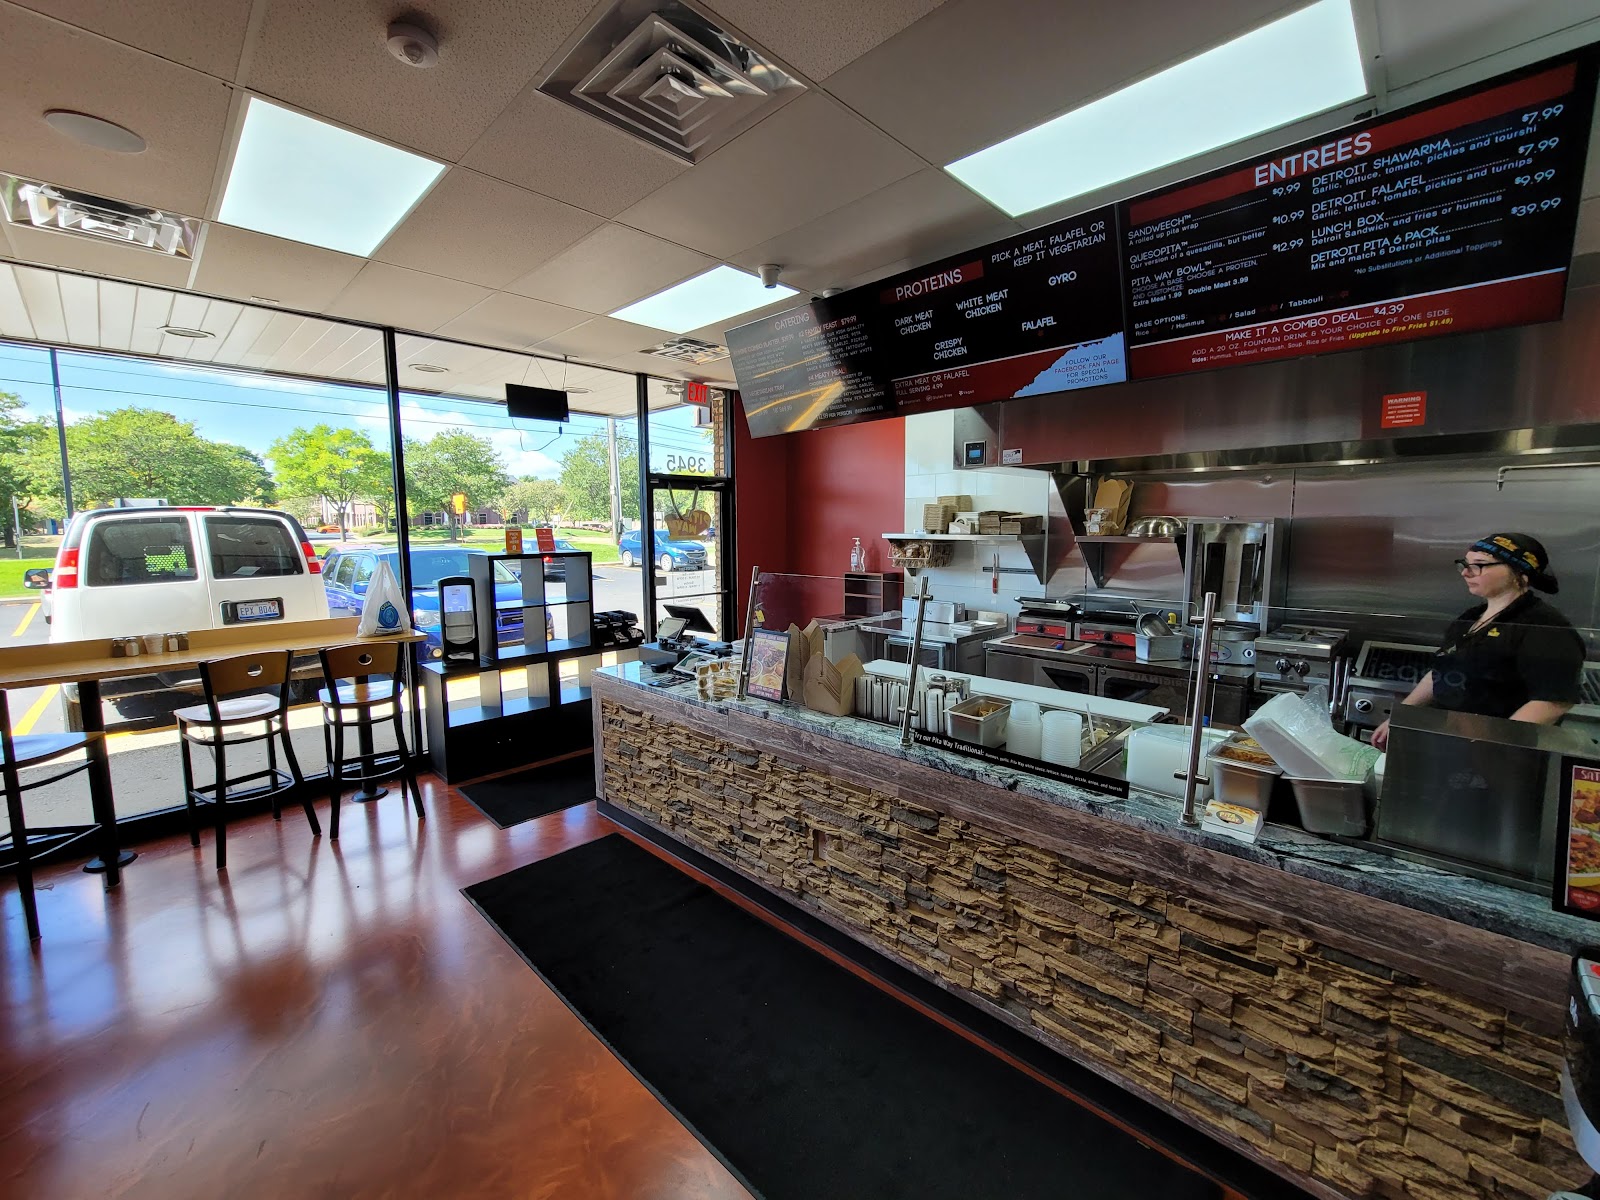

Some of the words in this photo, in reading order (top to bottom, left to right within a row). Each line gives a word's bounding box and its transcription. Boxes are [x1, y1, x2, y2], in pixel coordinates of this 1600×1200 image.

[1522, 104, 1563, 125] $7.99
[1427, 147, 1465, 164] pickles
[1470, 138, 1490, 150] and
[1495, 125, 1537, 142] tourshi
[1518, 137, 1559, 156] $7.99
[1255, 133, 1372, 186] ENTREES
[1313, 163, 1368, 187] DETROIT
[1373, 139, 1451, 169] SHAWARMA
[1425, 175, 1462, 192] pickles
[1467, 168, 1488, 180] and
[1492, 157, 1532, 174] turnips
[1515, 169, 1555, 187] $9.99
[1272, 182, 1300, 196] $9.99
[1312, 190, 1366, 213] DETROIT
[1372, 175, 1426, 197] FALAFEL
[1511, 197, 1561, 217] $39.99
[1272, 210, 1304, 225] $10.99
[1312, 234, 1341, 246] Detroit
[1345, 221, 1389, 238] Sandwich
[1393, 217, 1411, 226] and
[1415, 210, 1437, 221] fries
[1442, 205, 1452, 215] or
[1456, 195, 1502, 211] hummus
[1312, 221, 1351, 239] LUNCH
[1358, 212, 1385, 227] BOX
[992, 252, 1010, 263] PICK
[1014, 247, 1020, 256] A
[1049, 227, 1086, 245] FALAFEL
[1090, 221, 1105, 233] OR
[1135, 234, 1154, 244] rolled
[1156, 232, 1164, 240] up
[1167, 228, 1179, 237] pita
[1182, 222, 1199, 232] wrap
[1013, 254, 1033, 267] KEEP
[1036, 250, 1046, 261] IT
[1049, 233, 1106, 257] VEGETARIAN
[1131, 260, 1142, 270] Our
[1144, 256, 1168, 266] version
[1171, 252, 1177, 260] of
[1242, 230, 1265, 241] better
[1272, 239, 1304, 252] $12.99
[1311, 244, 1360, 263] DETROIT
[1364, 237, 1390, 251] PITA
[1394, 235, 1402, 243] 6
[1405, 226, 1439, 242] PACK
[1311, 260, 1325, 270] Mix
[1329, 257, 1345, 266] and
[1348, 248, 1376, 261] match
[1389, 241, 1422, 254] Detroit
[1426, 234, 1450, 246] pitas
[1368, 258, 1413, 273] Substitutions
[1425, 247, 1463, 260] Additional
[1466, 238, 1502, 252] Toppings
[896, 268, 963, 301] PROTEINS
[1048, 270, 1077, 286] GYRO
[1132, 274, 1151, 287] PITA
[1155, 270, 1173, 281] WAY
[1187, 269, 1215, 281] CHOOSE
[956, 297, 983, 311] WHITE
[986, 289, 1008, 302] MEAT
[1133, 299, 1149, 307] Extra
[1151, 295, 1166, 303] Meat
[1188, 285, 1212, 295] Double
[1214, 280, 1231, 289] Meat
[1233, 276, 1249, 285] 3.99
[895, 315, 913, 327] DARK
[915, 310, 933, 323] MEAT
[965, 303, 1002, 319] CHICKEN
[1176, 319, 1205, 329] Hummus
[1235, 309, 1256, 318] Salad
[1289, 296, 1323, 308] Tabbouli
[775, 312, 810, 331] CATERING
[823, 321, 837, 330] FEAST
[900, 321, 932, 335] CHICKEN
[1022, 316, 1057, 331] FALAFEL
[1135, 321, 1152, 329] BASE
[1154, 314, 1188, 325] OPTIONS:
[1225, 329, 1251, 341] MAKE
[1256, 327, 1267, 336] IT
[1271, 326, 1278, 334] A
[1283, 317, 1327, 332] COMBO
[1192, 355, 1209, 363] Sides:
[1349, 328, 1380, 340] (Upgrade
[1391, 324, 1406, 333] Fire
[1408, 321, 1427, 330] Fries
[1217, 344, 1226, 352] 20
[1244, 336, 1280, 347] FOUNTAIN
[1284, 331, 1307, 342] DRINK
[1320, 325, 1342, 335] YOUR
[1346, 320, 1381, 331] CHOICE
[1386, 316, 1398, 325] OF
[1402, 313, 1422, 322] ONE
[934, 346, 967, 360] CHICKEN
[935, 337, 963, 351] CRISPY
[1054, 364, 1086, 374] FACEBOOK
[1088, 361, 1100, 369] FAN
[1103, 358, 1119, 367] PAGE
[1065, 356, 1090, 365] FOLLOW
[1093, 353, 1107, 361] OUR
[915, 377, 929, 385] MEAT
[944, 370, 970, 380] FALAFEL
[1066, 370, 1078, 378] FOR
[1081, 367, 1107, 376] SPECIAL
[1067, 374, 1108, 384] PROMOTIONS
[688, 382, 707, 404] EXIT
[909, 385, 930, 394] SERVING
[1388, 396, 1421, 404] WARNING
[240, 607, 254, 615] EPX
[259, 606, 276, 614] 8042
[914, 732, 922, 740] Try
[932, 736, 942, 744] Pita
[943, 739, 953, 748] Way
[954, 742, 984, 756] Traditional:
